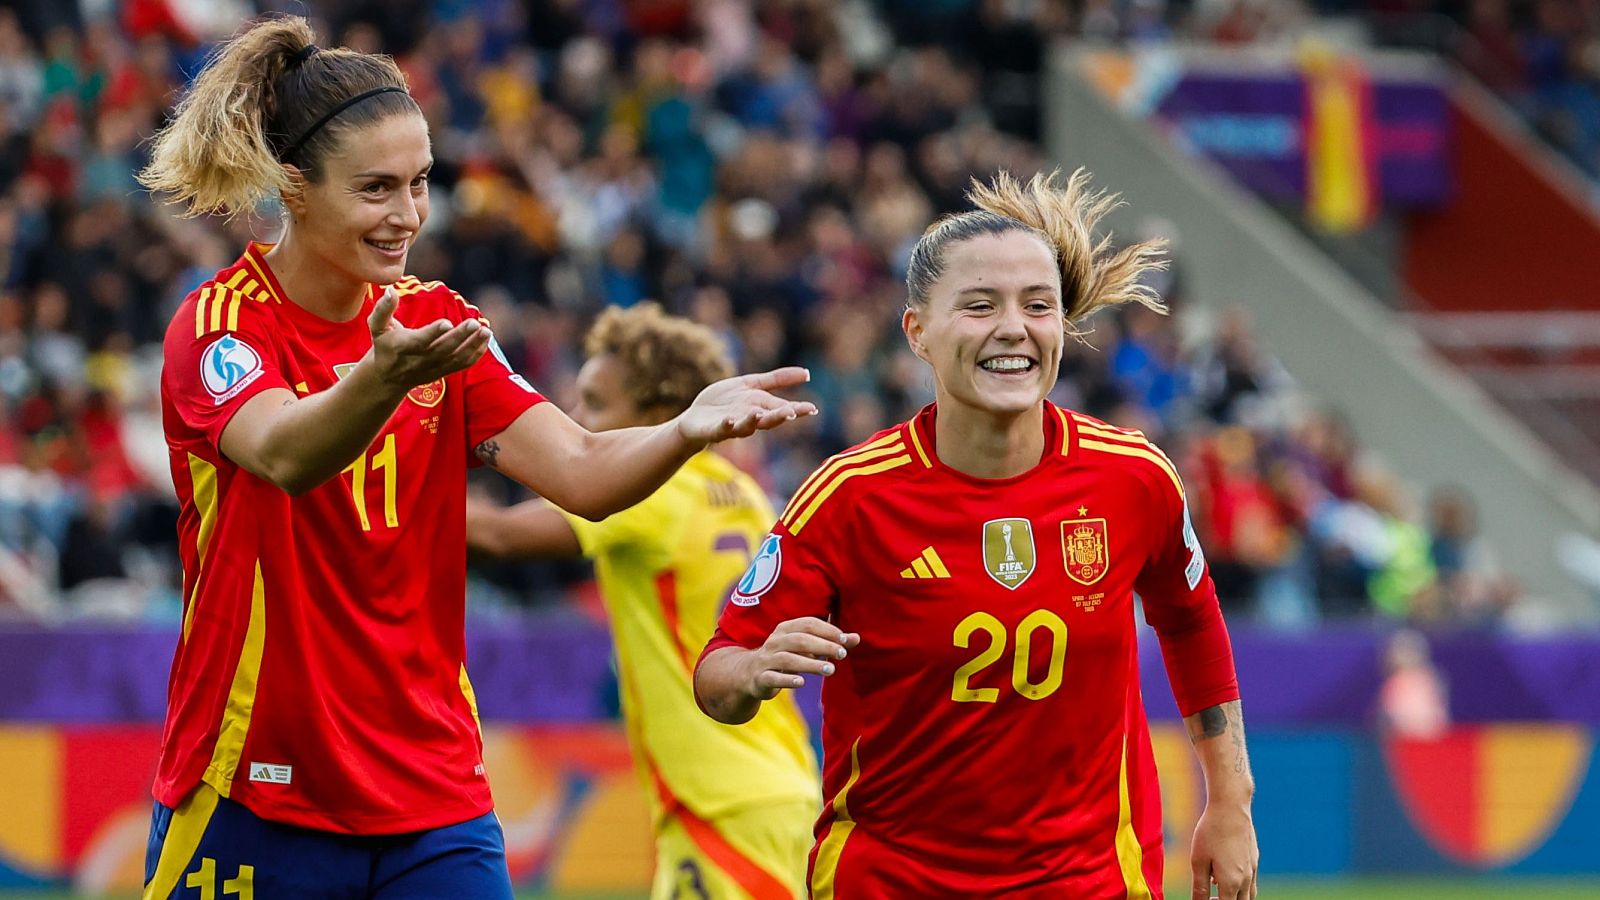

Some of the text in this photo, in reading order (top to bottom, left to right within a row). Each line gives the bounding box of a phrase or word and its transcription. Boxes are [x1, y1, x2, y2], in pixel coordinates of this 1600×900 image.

[340, 432, 399, 532] 11
[999, 561, 1023, 572] FIFA
[951, 608, 1068, 703] 20
